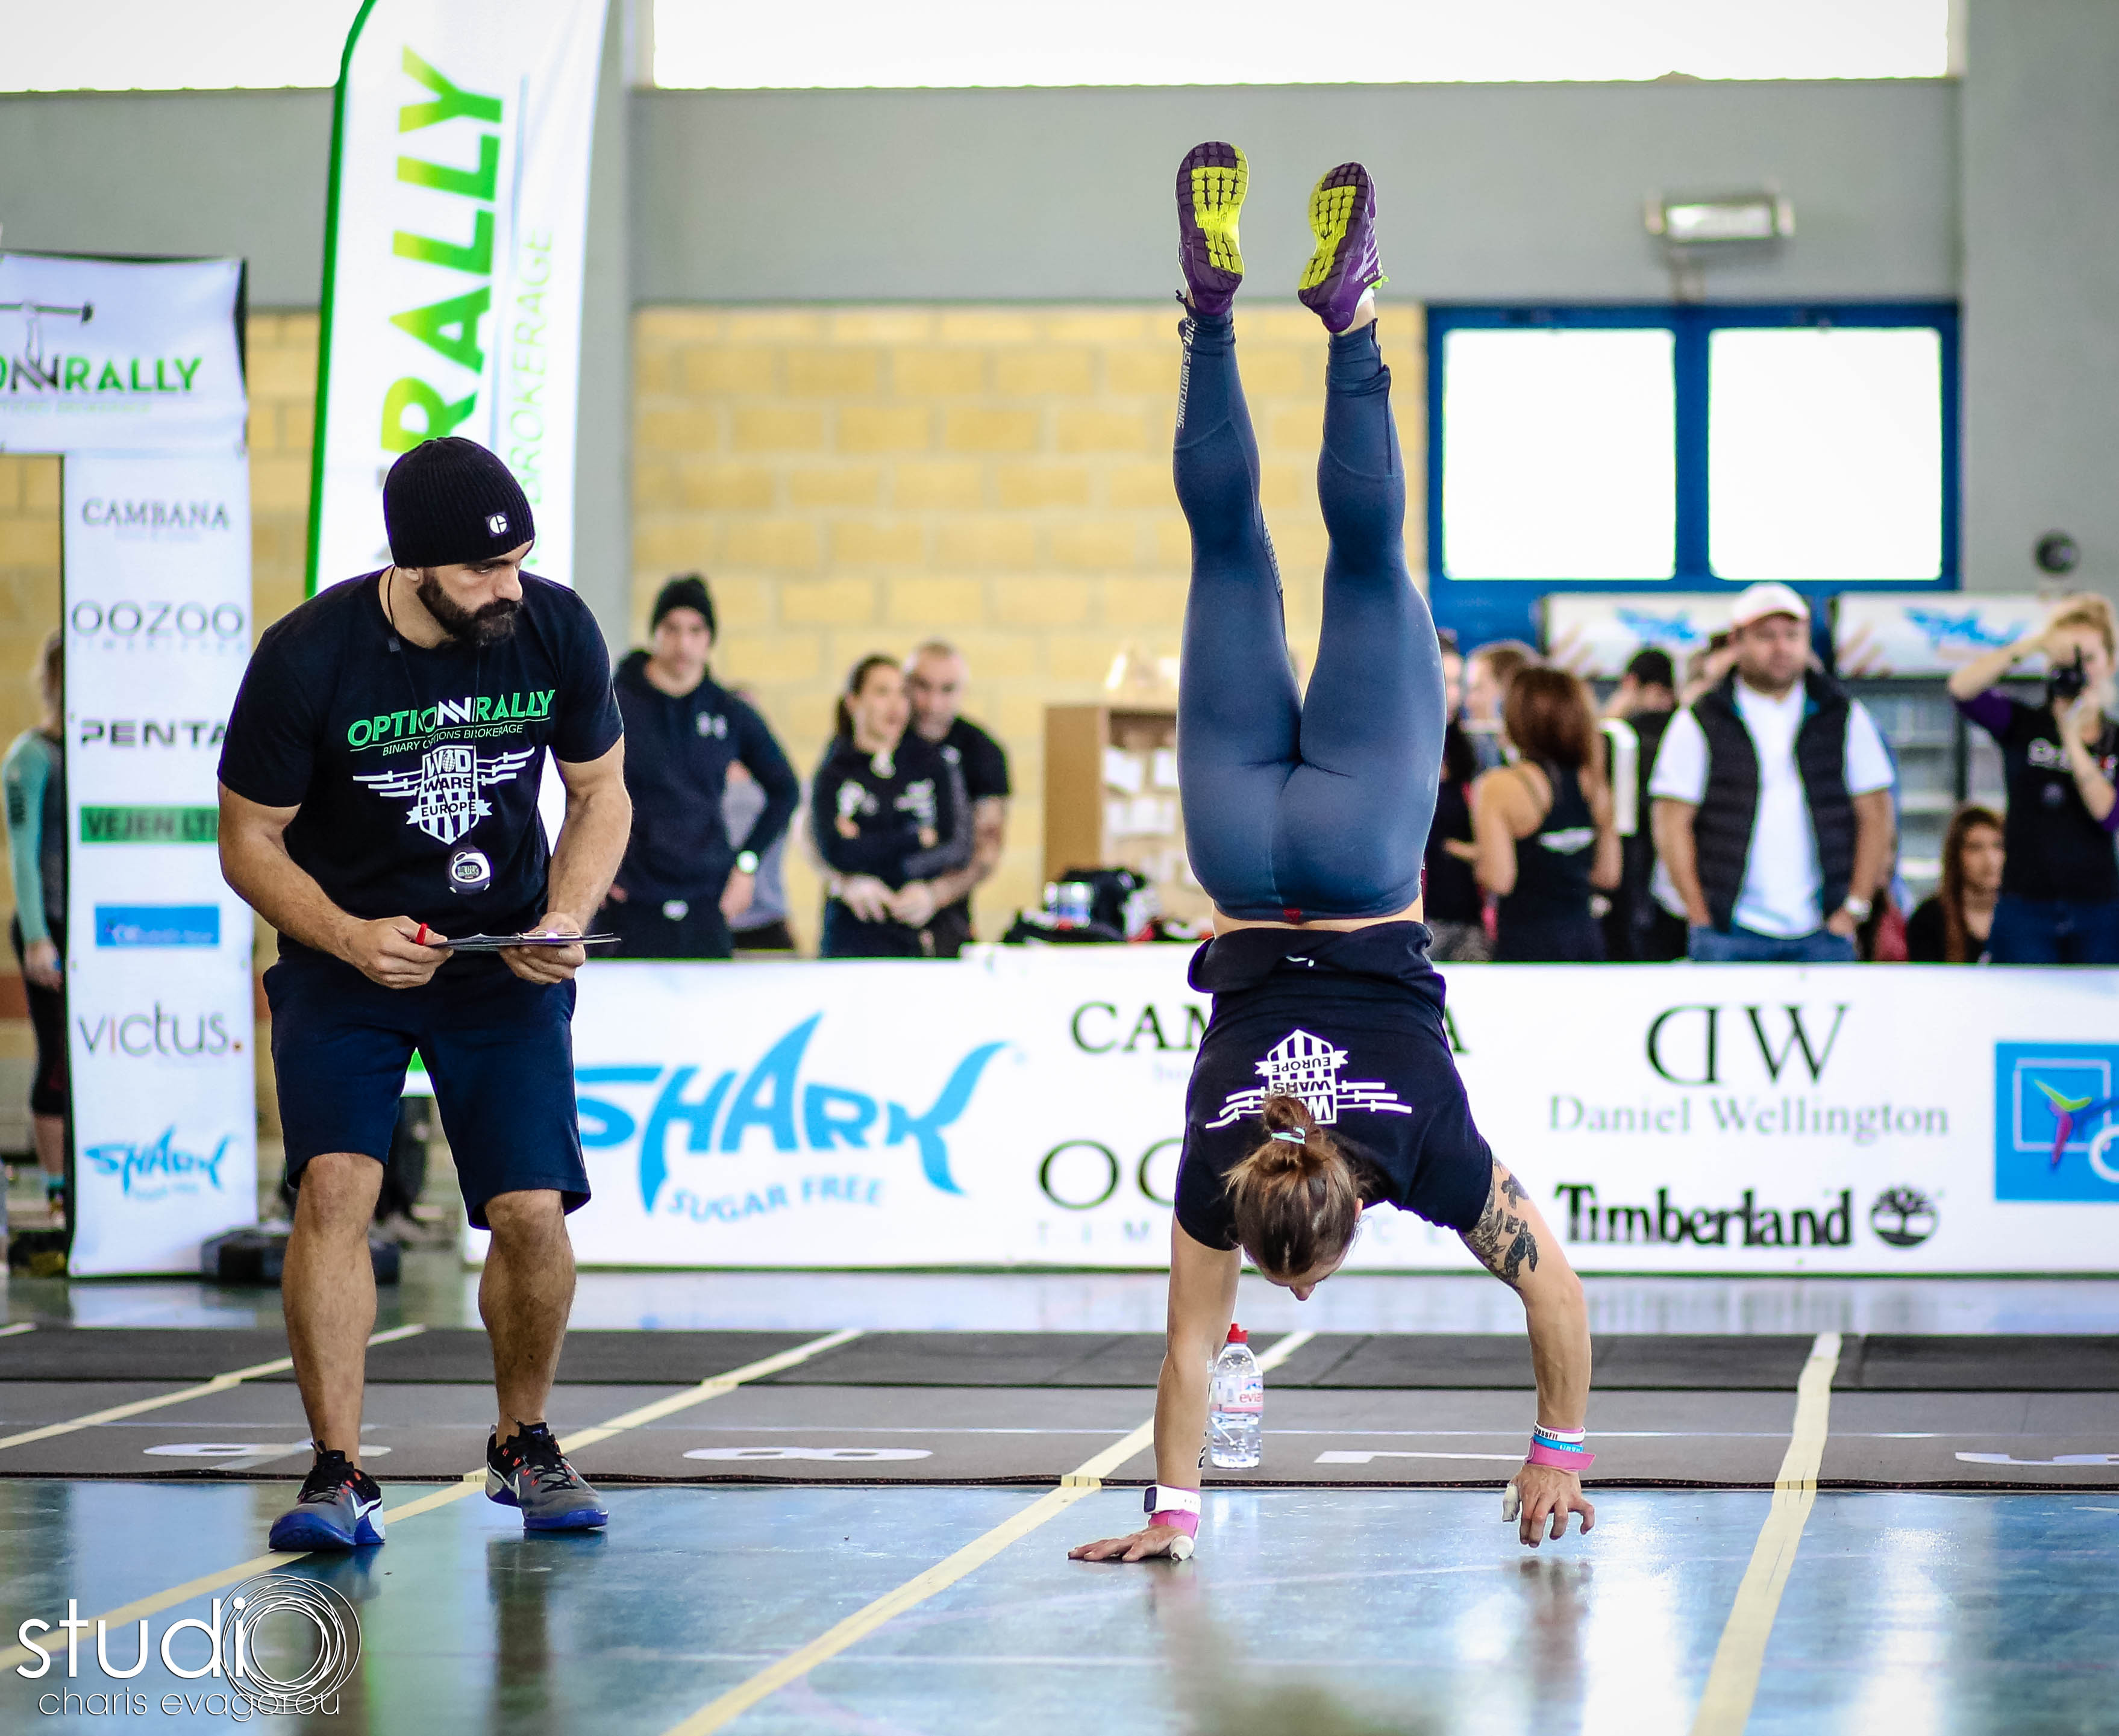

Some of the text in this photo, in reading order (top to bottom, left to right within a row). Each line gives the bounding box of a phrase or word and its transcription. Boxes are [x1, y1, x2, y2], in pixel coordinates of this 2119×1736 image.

[378, 45, 503, 473] RALLY
[0, 354, 203, 392] NRALLY
[1177, 364, 1191, 429] WATCHING
[82, 499, 230, 529] CAMBANA
[72, 601, 244, 637] OOZOO
[81, 721, 225, 746] PENTA
[382, 723, 524, 757] BINARY OPTIONS BROKERAGE
[424, 776, 472, 793] WARS
[421, 801, 477, 817] EUROPE
[1271, 1057, 1331, 1073] EUROPE
[1272, 1080, 1332, 1094] WARS
[1549, 1094, 1949, 1146] Daniel Wellington
[83, 1125, 238, 1196] SHARK
[667, 1175, 886, 1223] SUGAR FREE
[1553, 1182, 1853, 1247] Timberland
